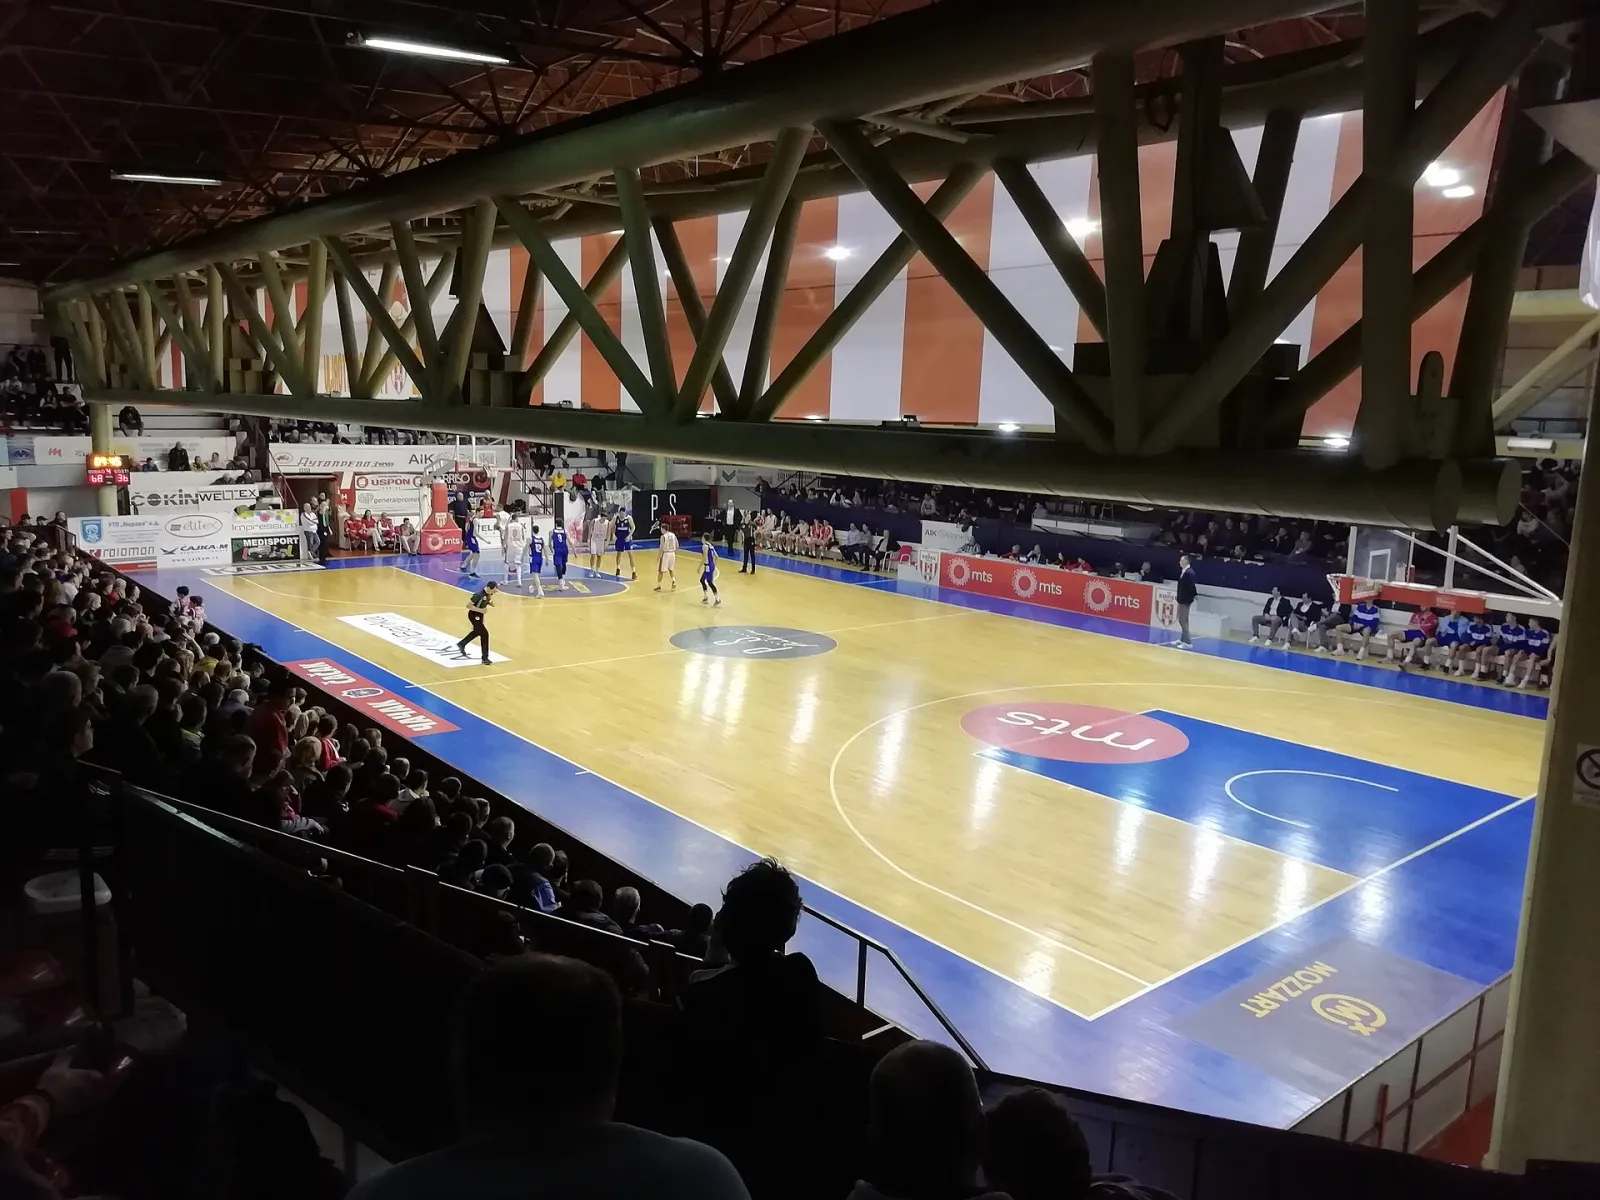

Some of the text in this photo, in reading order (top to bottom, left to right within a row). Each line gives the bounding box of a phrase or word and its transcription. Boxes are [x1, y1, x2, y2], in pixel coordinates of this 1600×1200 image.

[371, 478, 410, 487] USPON
[200, 489, 257, 501] WELTEX
[924, 529, 938, 537] AIK
[243, 536, 299, 547] MEDISPORT
[444, 535, 460, 546] mts
[971, 570, 993, 584] mts
[1038, 581, 1062, 595] mts
[1113, 595, 1140, 609] mts
[996, 711, 1156, 751] mts
[1239, 960, 1339, 1018] MOZZART
